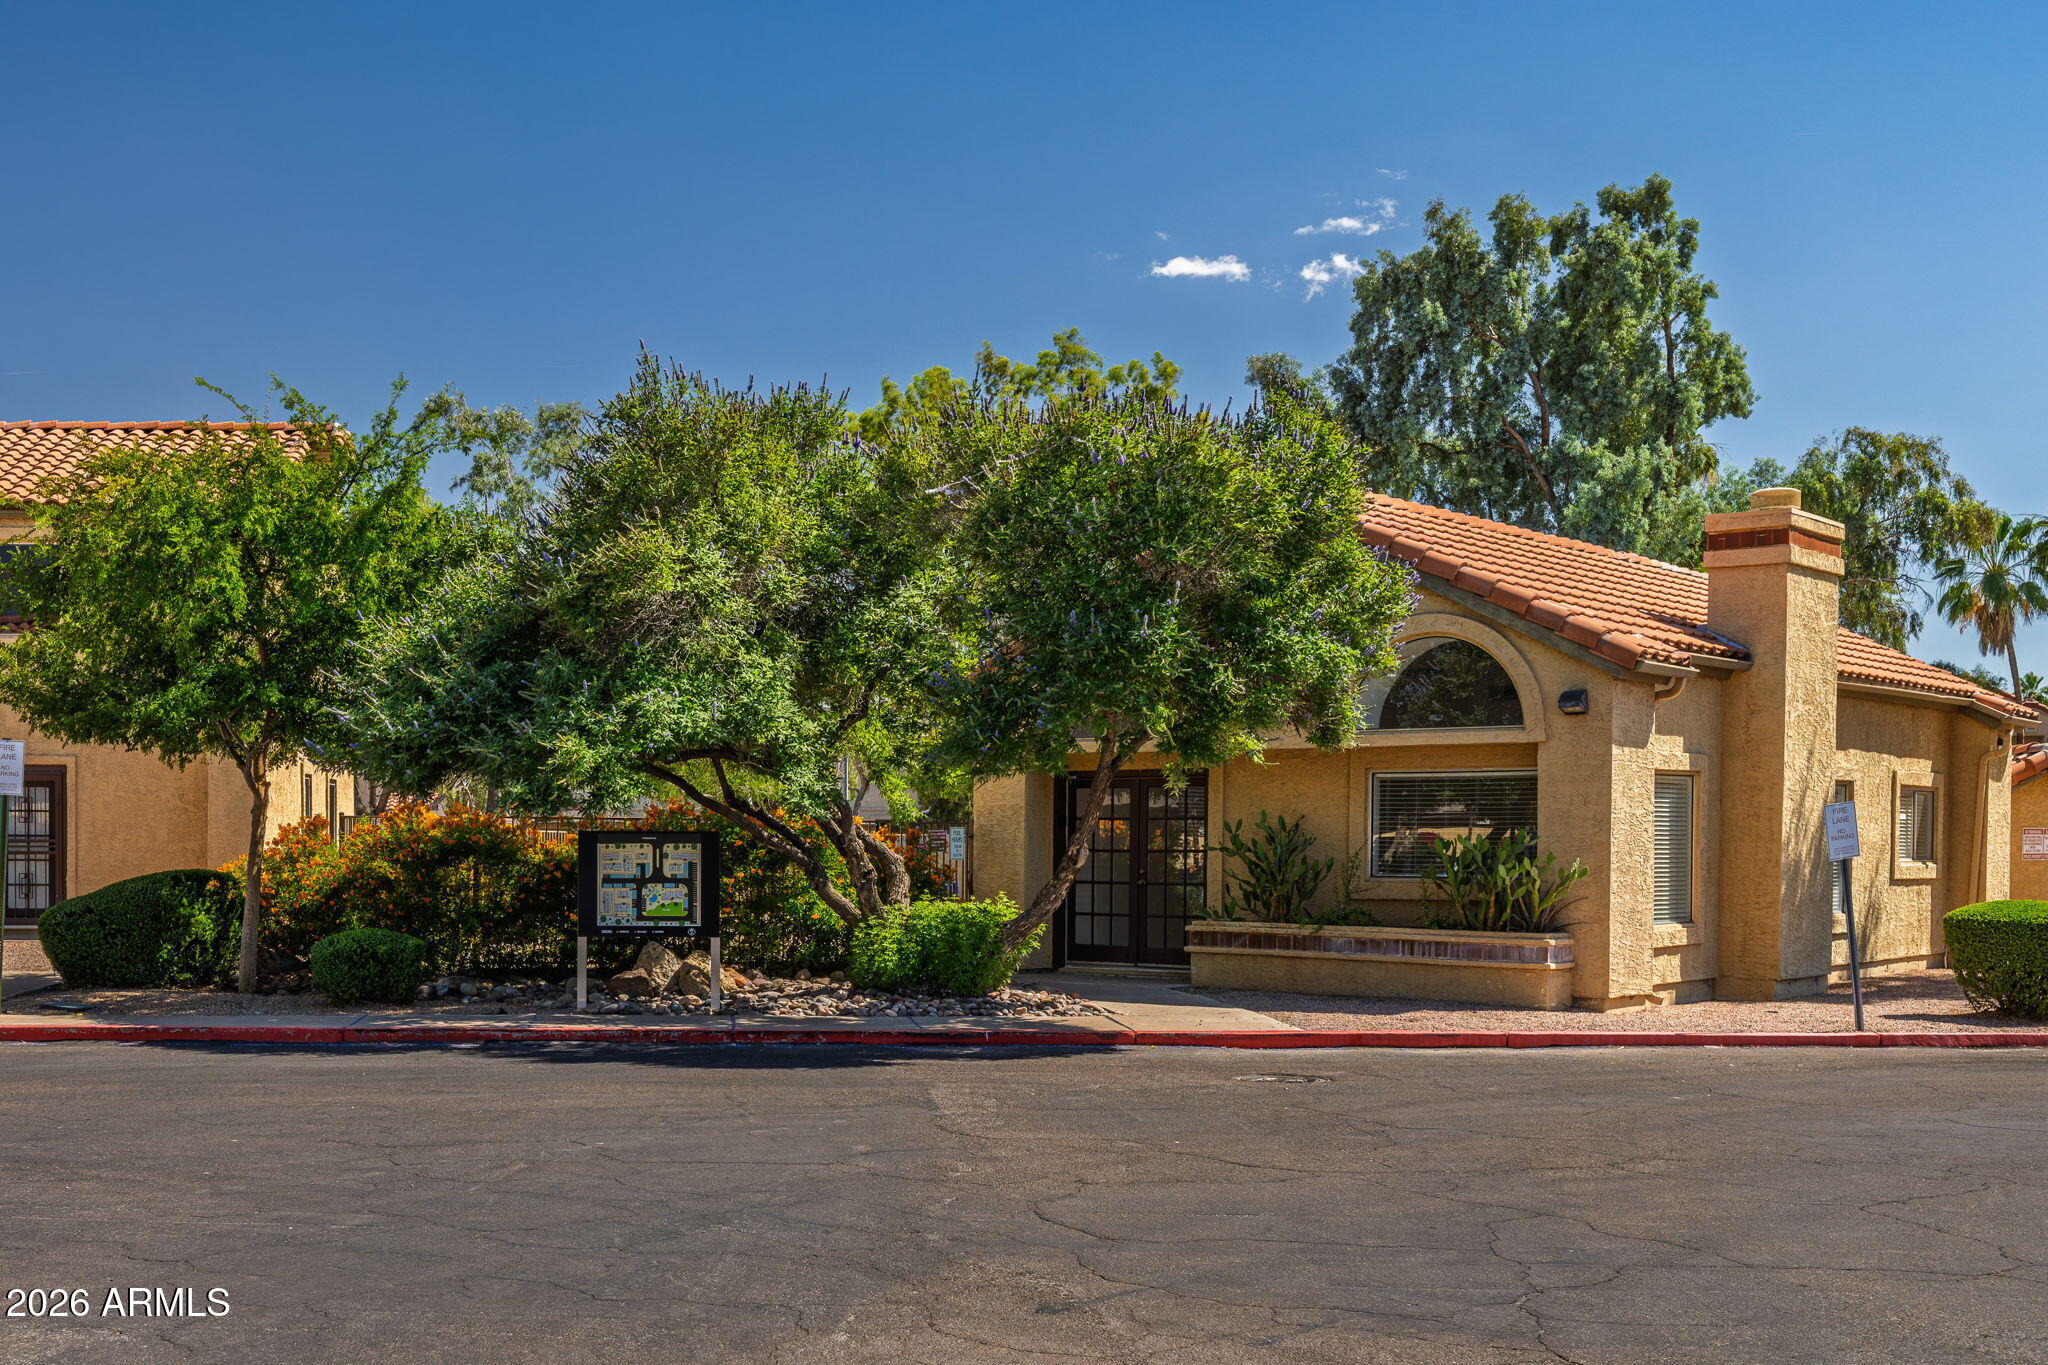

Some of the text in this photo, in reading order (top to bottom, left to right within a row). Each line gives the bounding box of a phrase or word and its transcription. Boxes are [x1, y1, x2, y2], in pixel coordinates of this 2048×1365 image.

[1832, 807, 1848, 815] FIRE
[1832, 816, 1850, 824] LANE
[1830, 833, 1855, 841] PARKING
